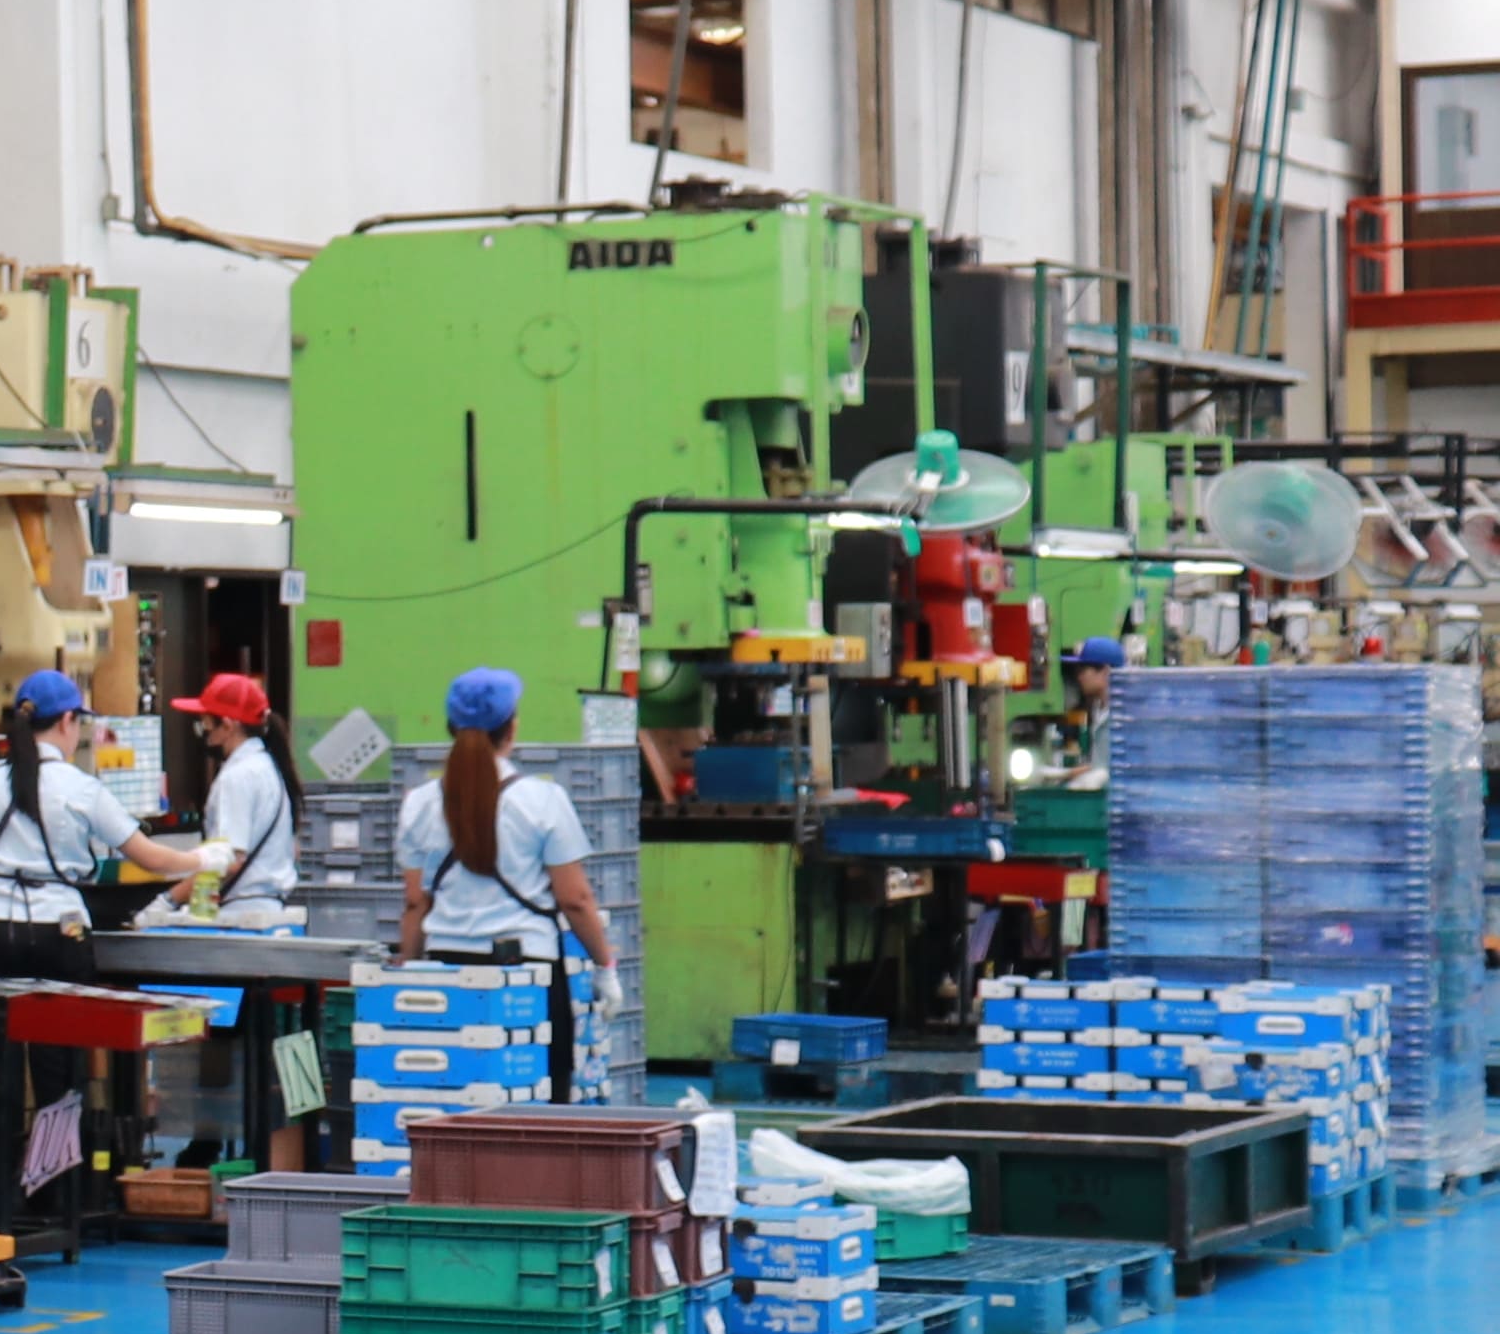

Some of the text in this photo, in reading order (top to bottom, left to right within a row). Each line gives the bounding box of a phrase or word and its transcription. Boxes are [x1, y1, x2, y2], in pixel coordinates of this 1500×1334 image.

[569, 239, 673, 271] AIDA
[77, 319, 92, 369] 6
[89, 567, 108, 591] IN
